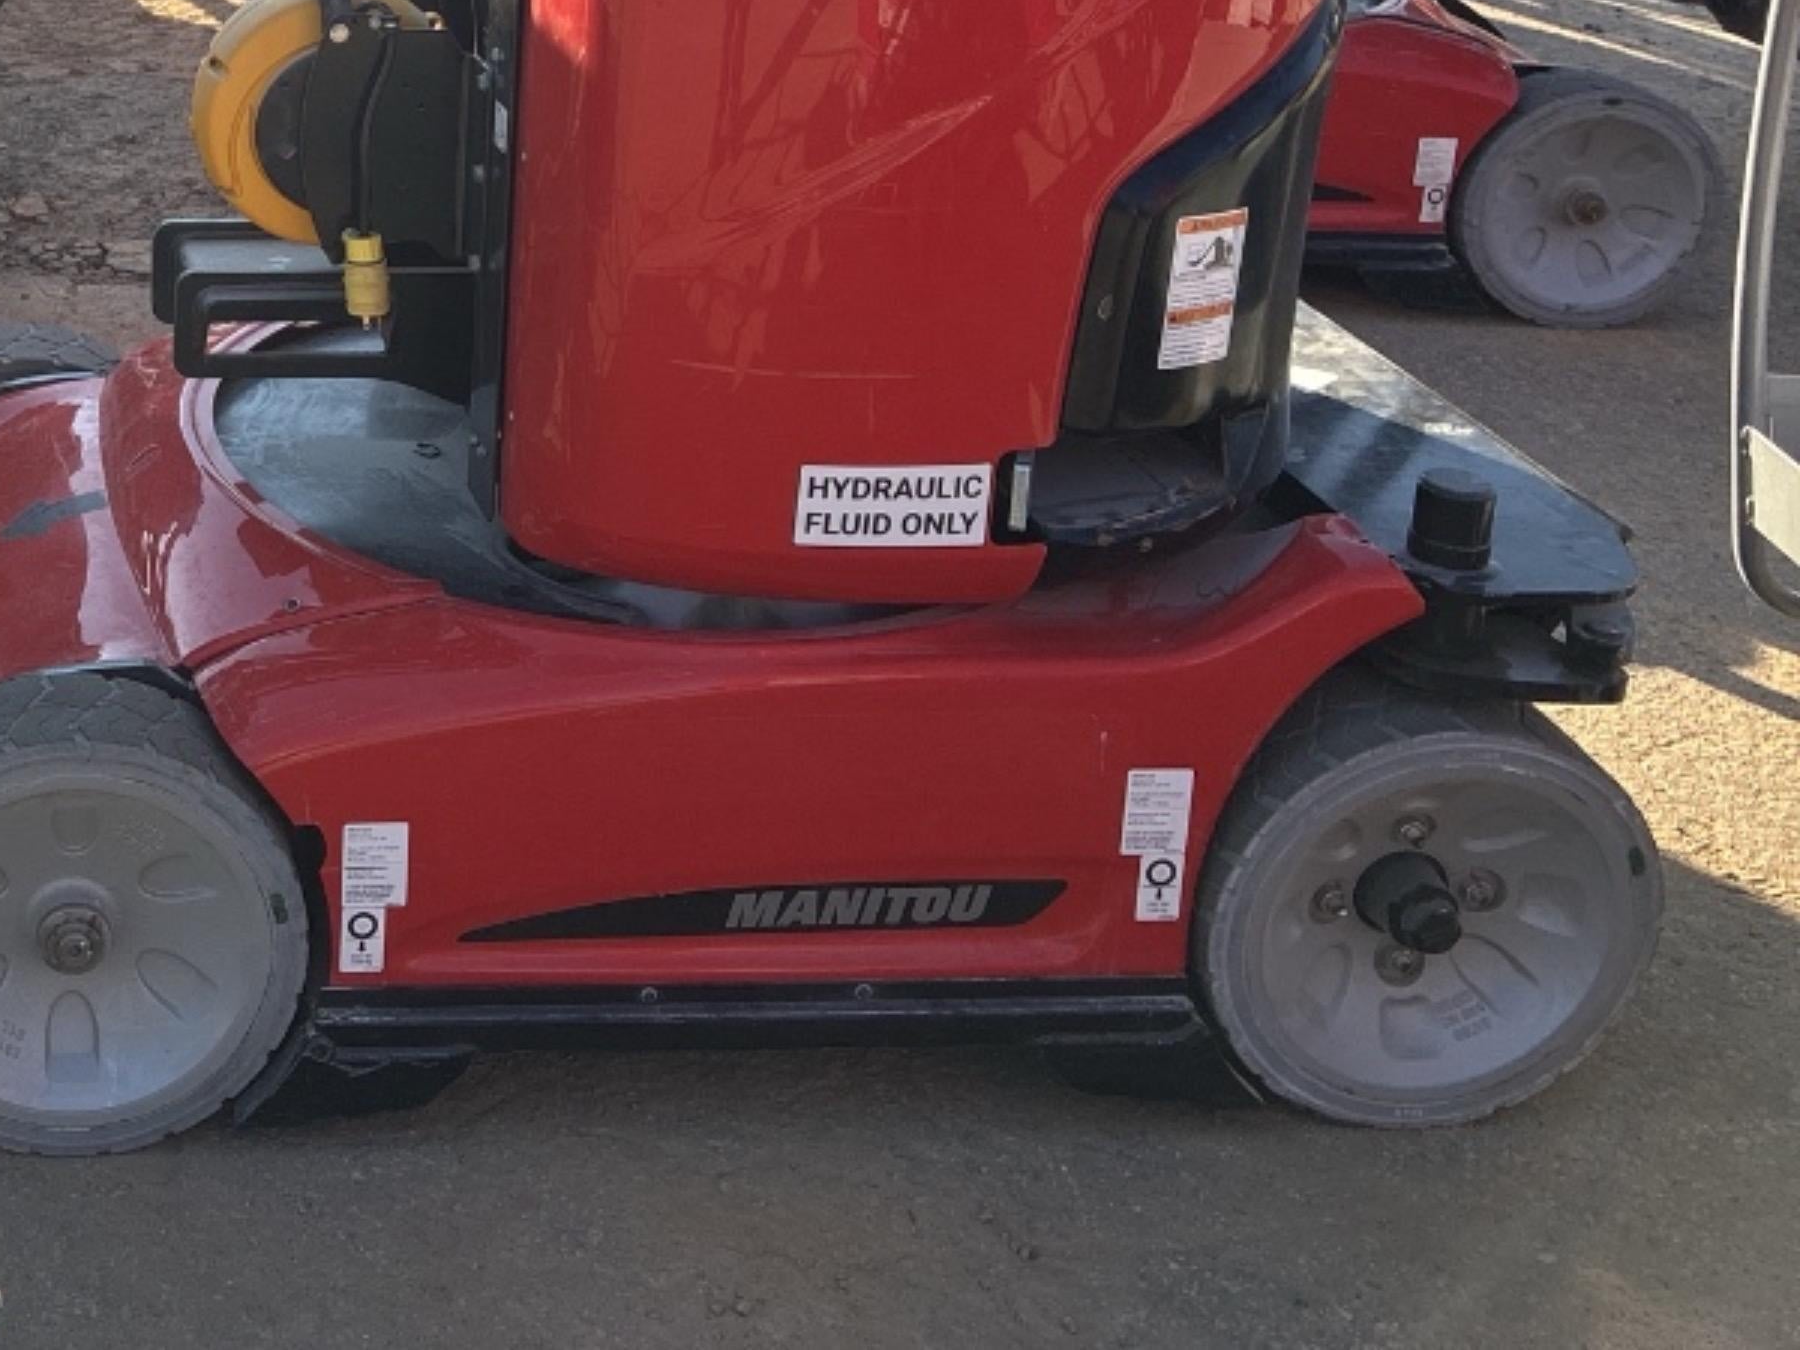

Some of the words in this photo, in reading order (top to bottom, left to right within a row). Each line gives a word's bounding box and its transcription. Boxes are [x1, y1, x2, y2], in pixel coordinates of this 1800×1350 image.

[807, 475, 983, 500] HYDRAULIC
[804, 512, 893, 536] FLUID
[902, 511, 979, 536] ONLY
[725, 883, 993, 929] MANITOU
